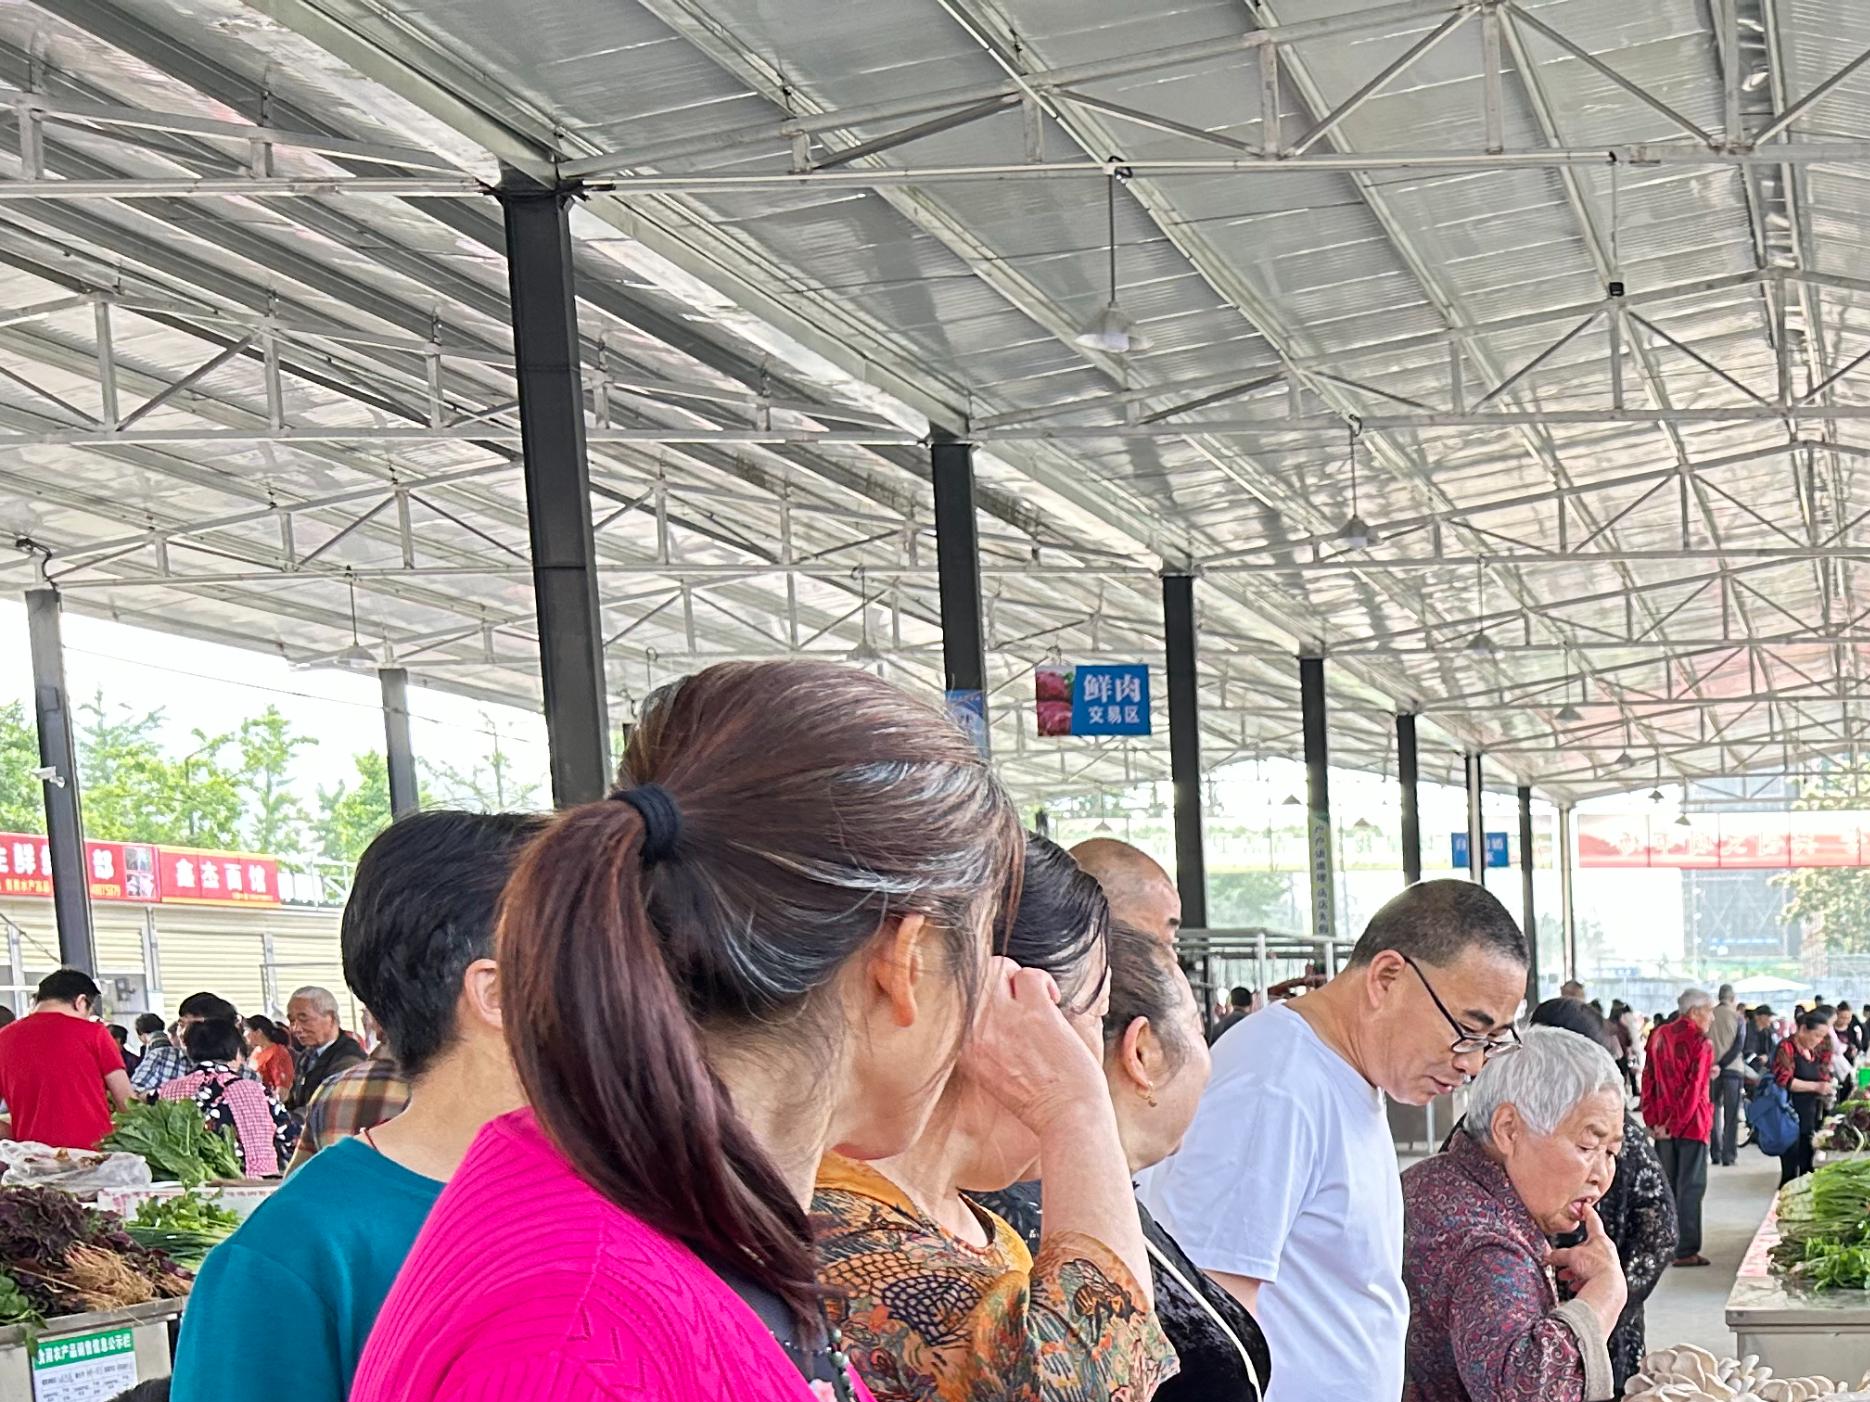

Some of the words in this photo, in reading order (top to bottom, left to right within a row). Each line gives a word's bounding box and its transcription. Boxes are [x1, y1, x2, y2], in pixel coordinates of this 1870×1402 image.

[1083, 673, 1141, 704] 鲜肉
[1087, 705, 1141, 725] 交易区
[175, 858, 267, 893] 鑫杰面馆
